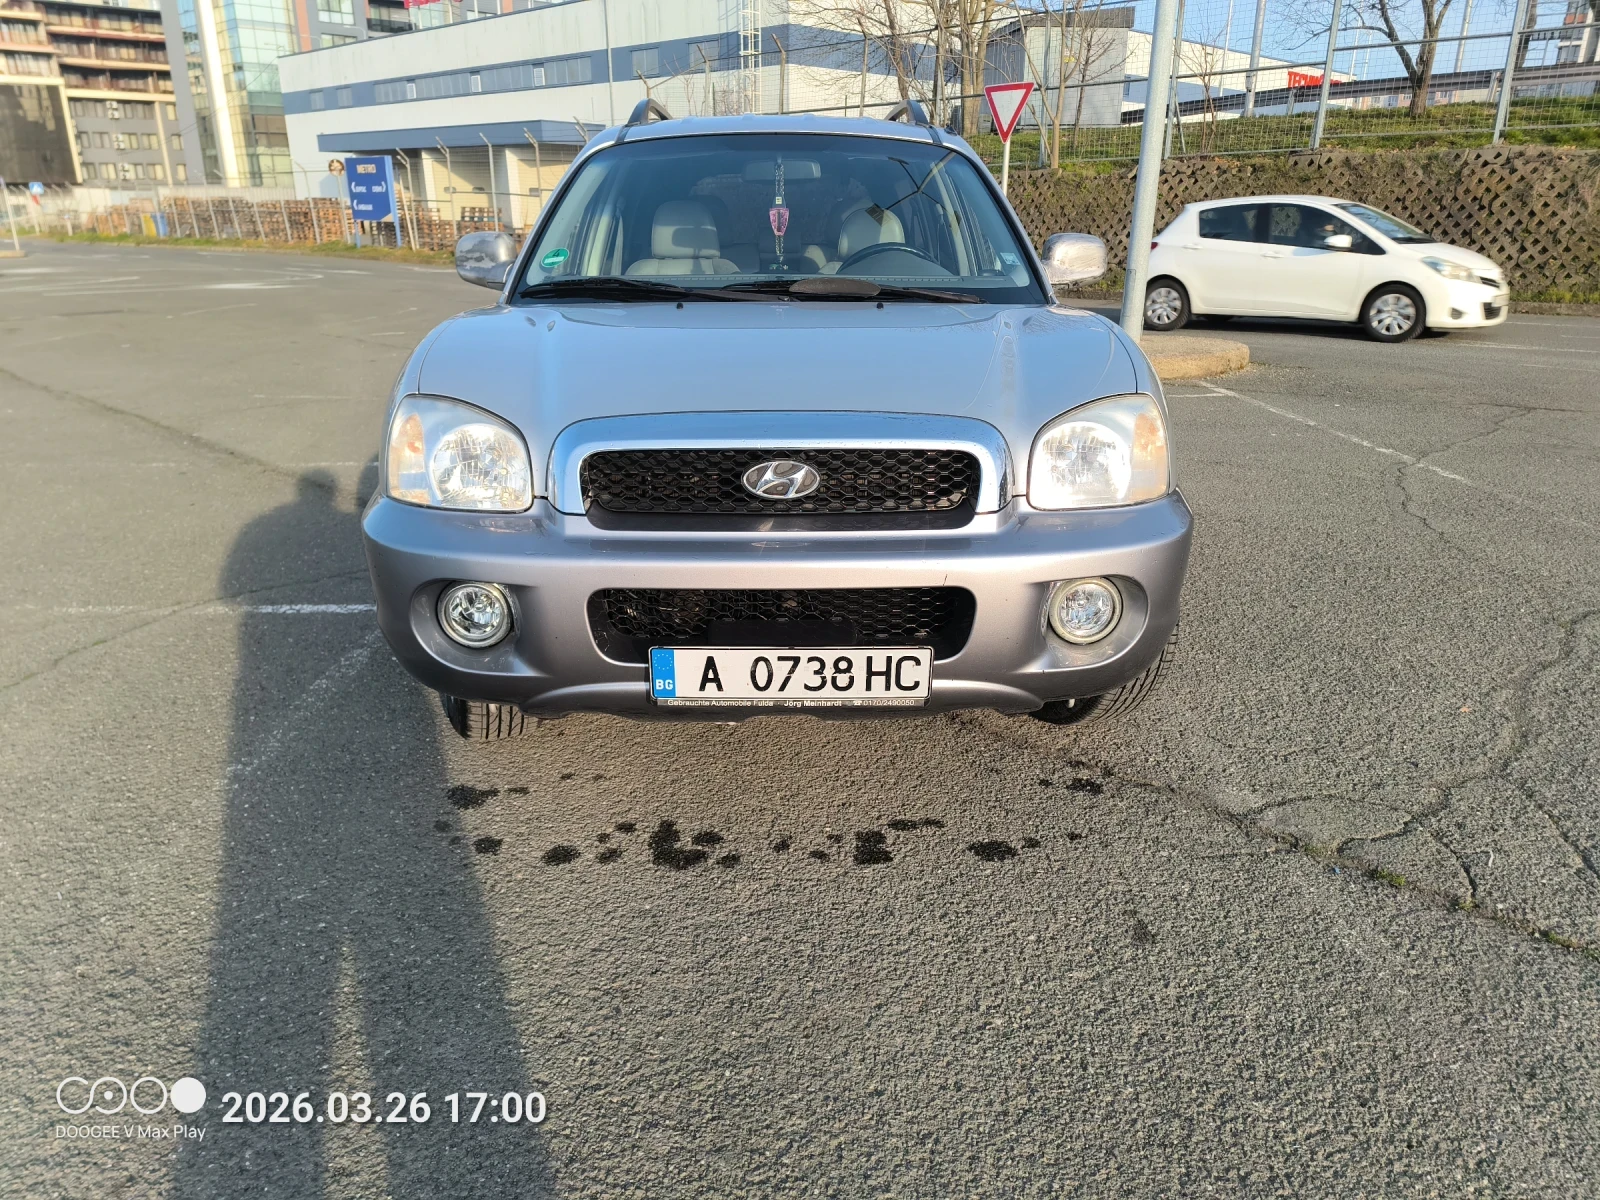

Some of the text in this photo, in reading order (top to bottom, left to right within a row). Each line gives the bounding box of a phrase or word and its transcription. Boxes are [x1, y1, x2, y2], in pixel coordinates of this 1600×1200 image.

[699, 656, 922, 692] A 0738 HC
[655, 679, 674, 690] BG
[667, 699, 710, 707] Gebrauchte
[711, 699, 751, 707] Automobile
[753, 699, 774, 707] Fulda
[803, 699, 842, 707] Meinhardt
